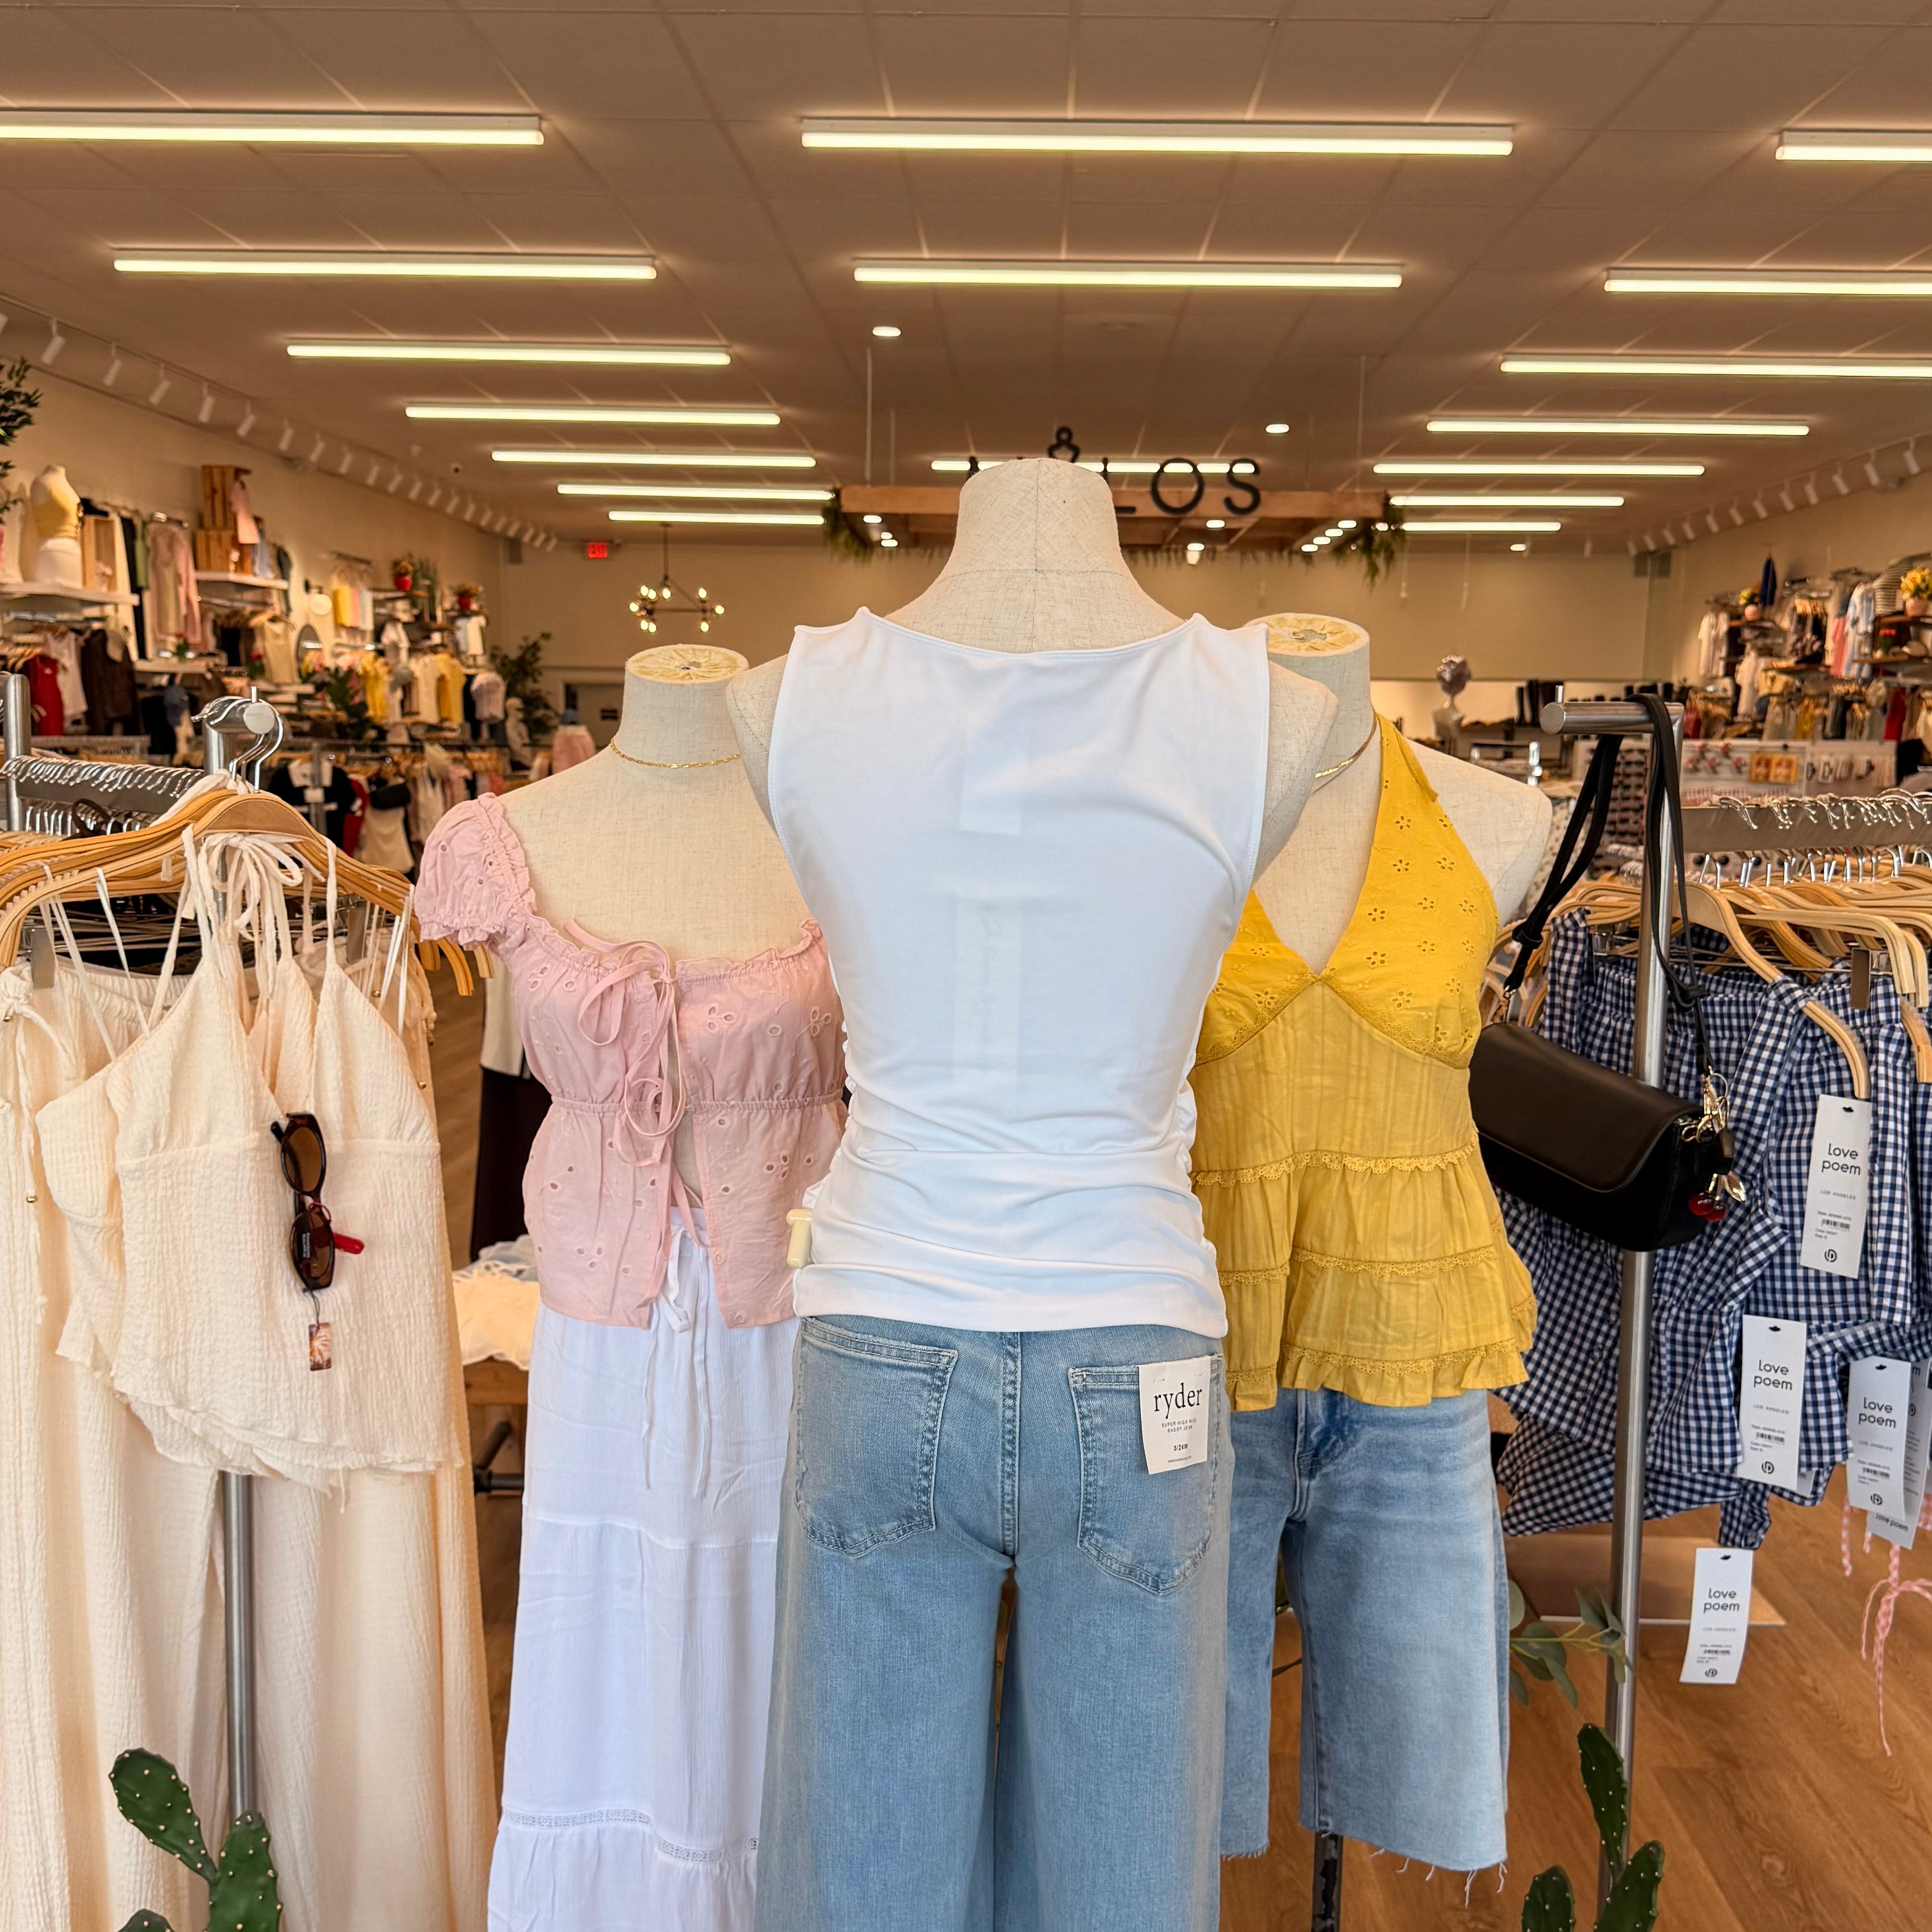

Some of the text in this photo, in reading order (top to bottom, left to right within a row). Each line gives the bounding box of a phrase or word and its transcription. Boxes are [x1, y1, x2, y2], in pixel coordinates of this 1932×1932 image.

[1821, 1159, 1860, 1176] poem
[1754, 1375, 1792, 1390] poem
[1154, 1382, 1202, 1419] ryder
[1858, 1413, 1896, 1428] poem
[1704, 1601, 1739, 1613] poem
